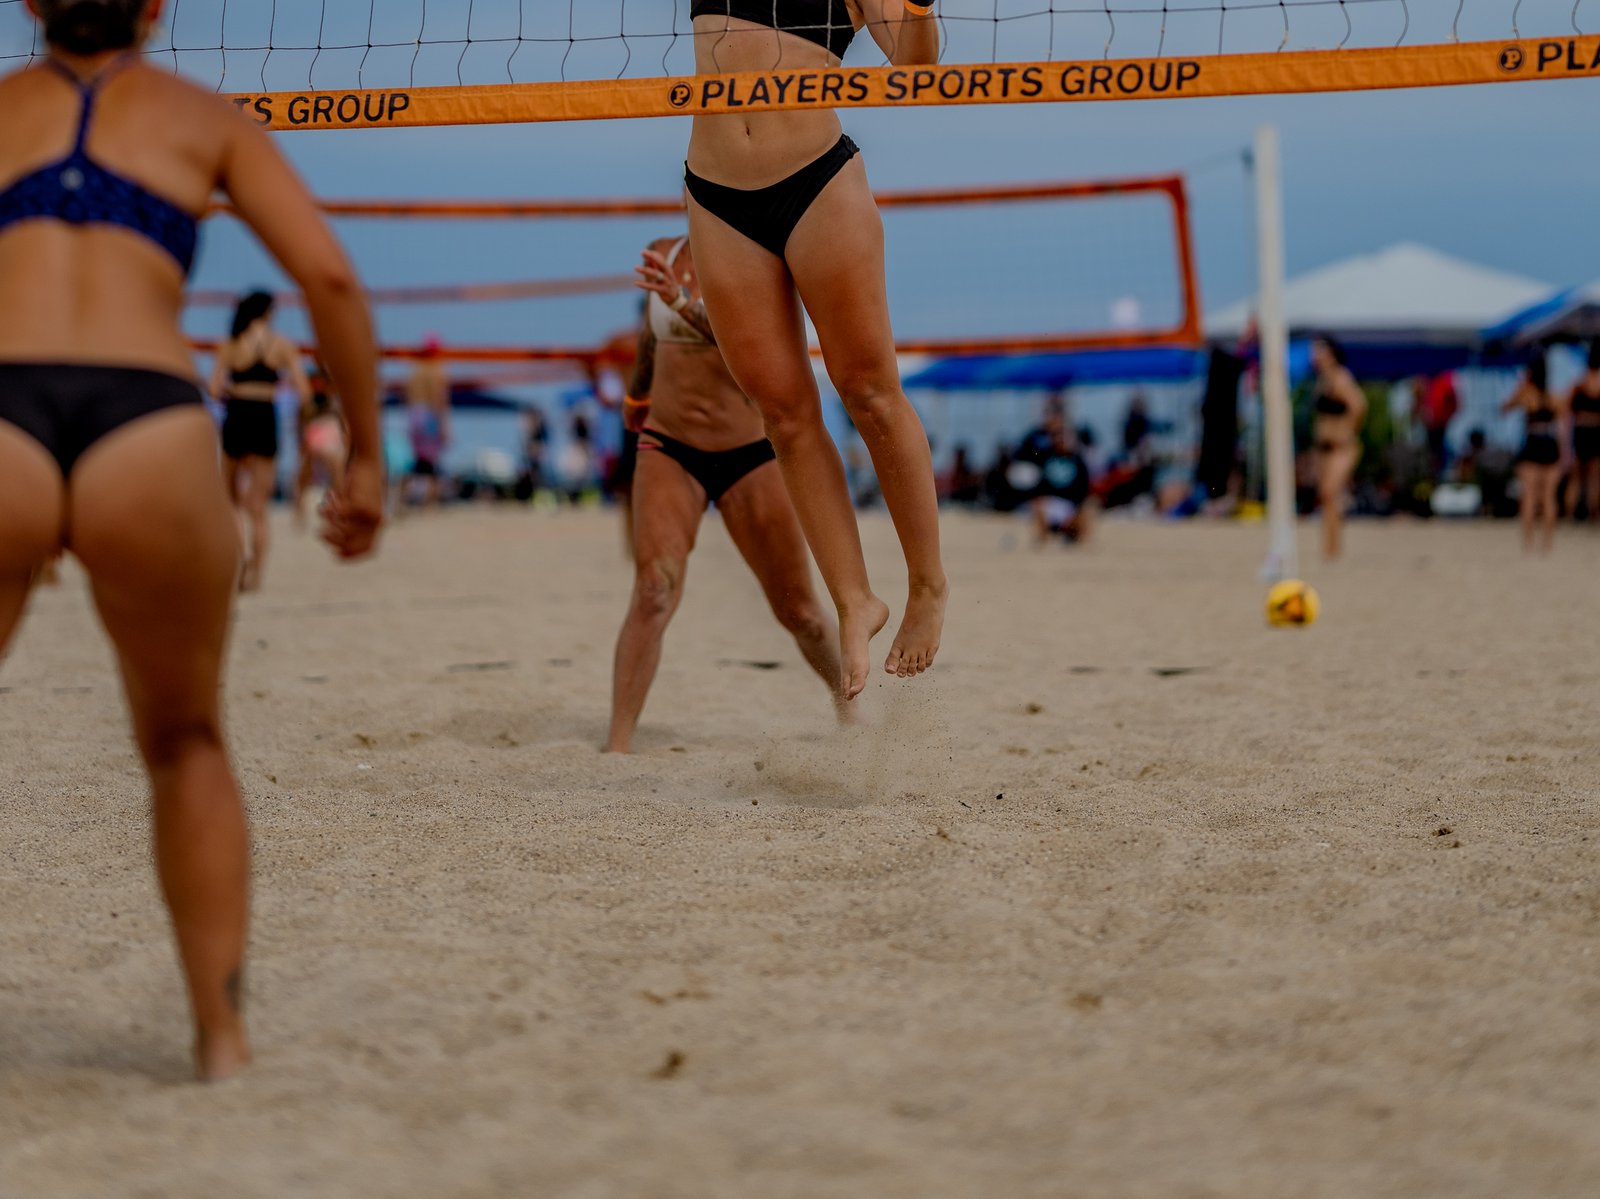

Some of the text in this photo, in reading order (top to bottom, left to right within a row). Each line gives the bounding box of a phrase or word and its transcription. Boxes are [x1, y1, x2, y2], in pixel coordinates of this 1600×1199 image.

[701, 71, 869, 108] PLAYERS
[885, 62, 1043, 100] SPORTS
[1060, 61, 1201, 96] GROUP
[287, 93, 410, 125] GROUP
